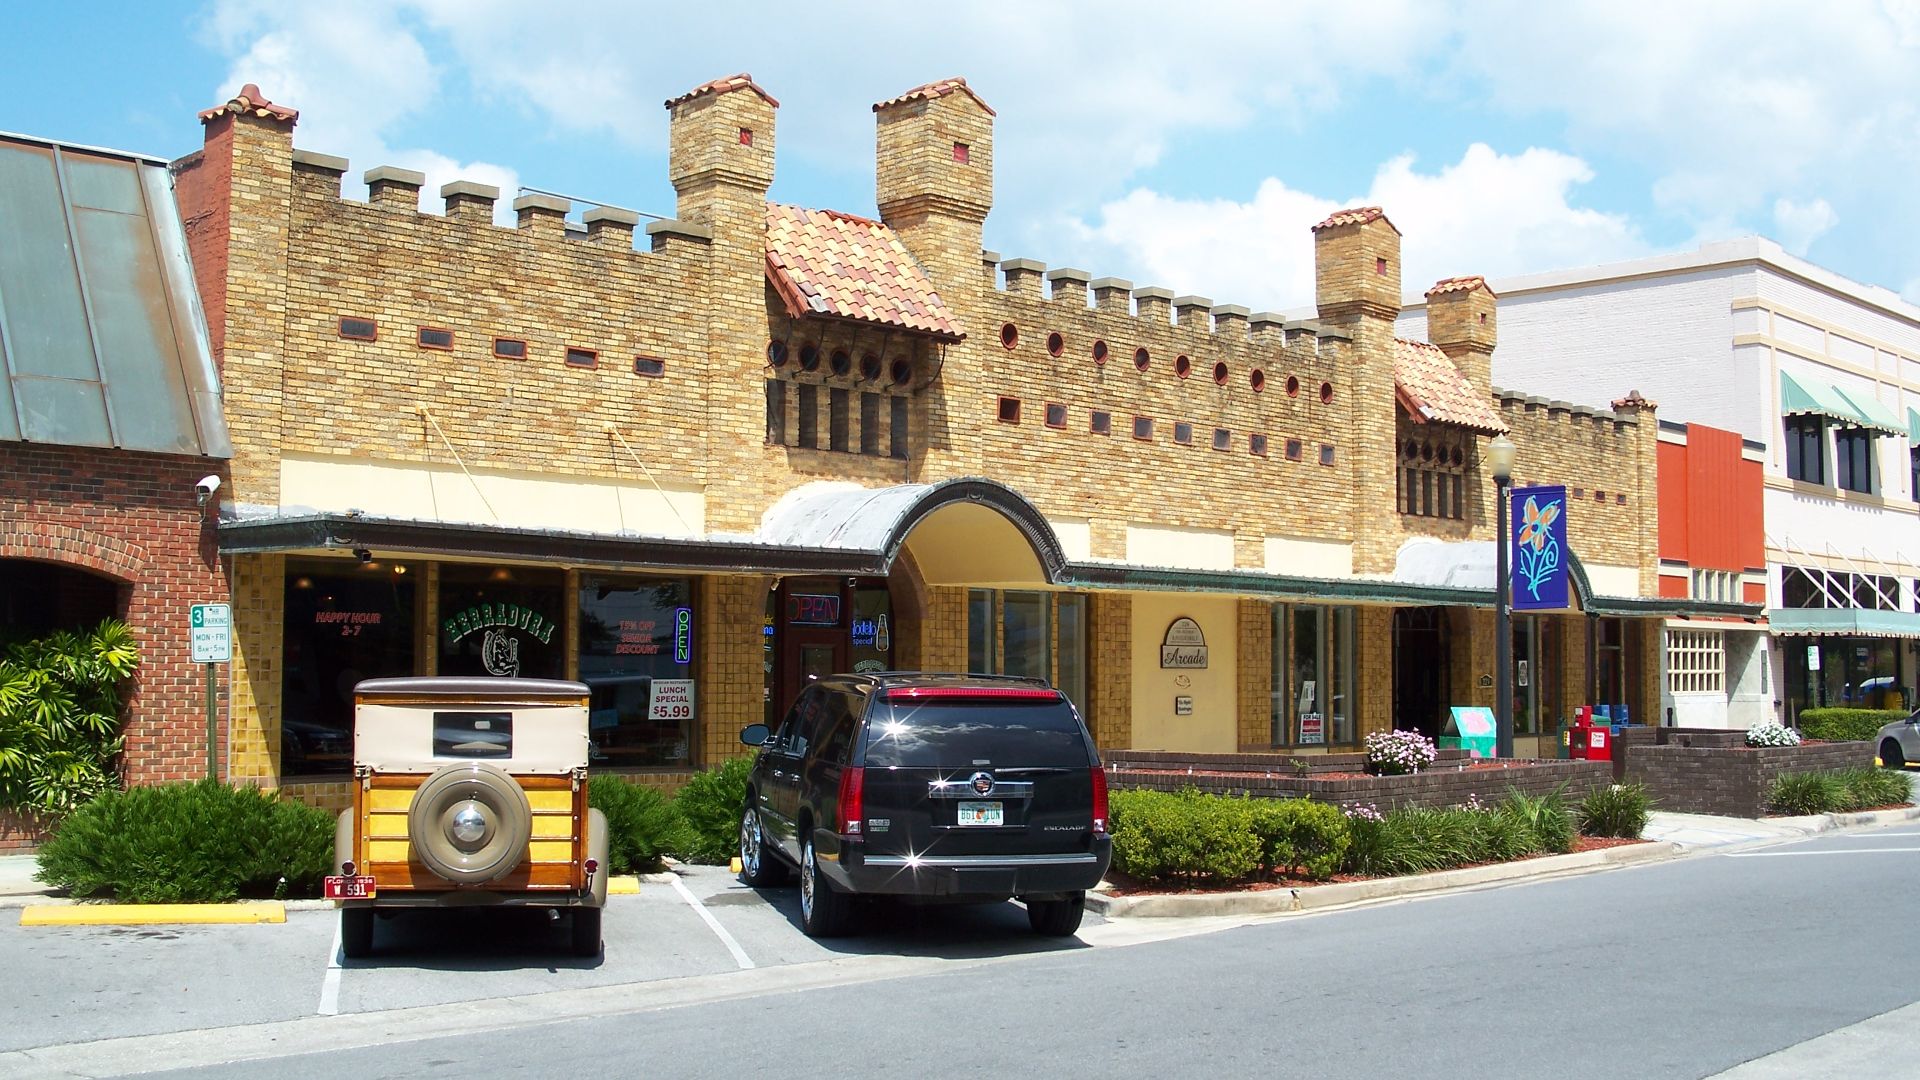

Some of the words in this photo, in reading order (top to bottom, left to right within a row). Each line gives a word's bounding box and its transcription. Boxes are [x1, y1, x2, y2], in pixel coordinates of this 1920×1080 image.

[788, 597, 836, 621] OPEN
[194, 609, 203, 624] 3
[316, 611, 350, 623] HAPPY
[351, 612, 381, 623] HOUR
[621, 633, 653, 642] SENIOR
[678, 610, 689, 660] OPEN
[616, 644, 660, 654] DISCOUNT
[1164, 648, 1205, 665] Arcade
[659, 686, 686, 694] LUNCH
[655, 695, 689, 703] SPECIAL
[653, 705, 690, 718] $5.99
[334, 885, 341, 895] W
[347, 884, 366, 895] 591
